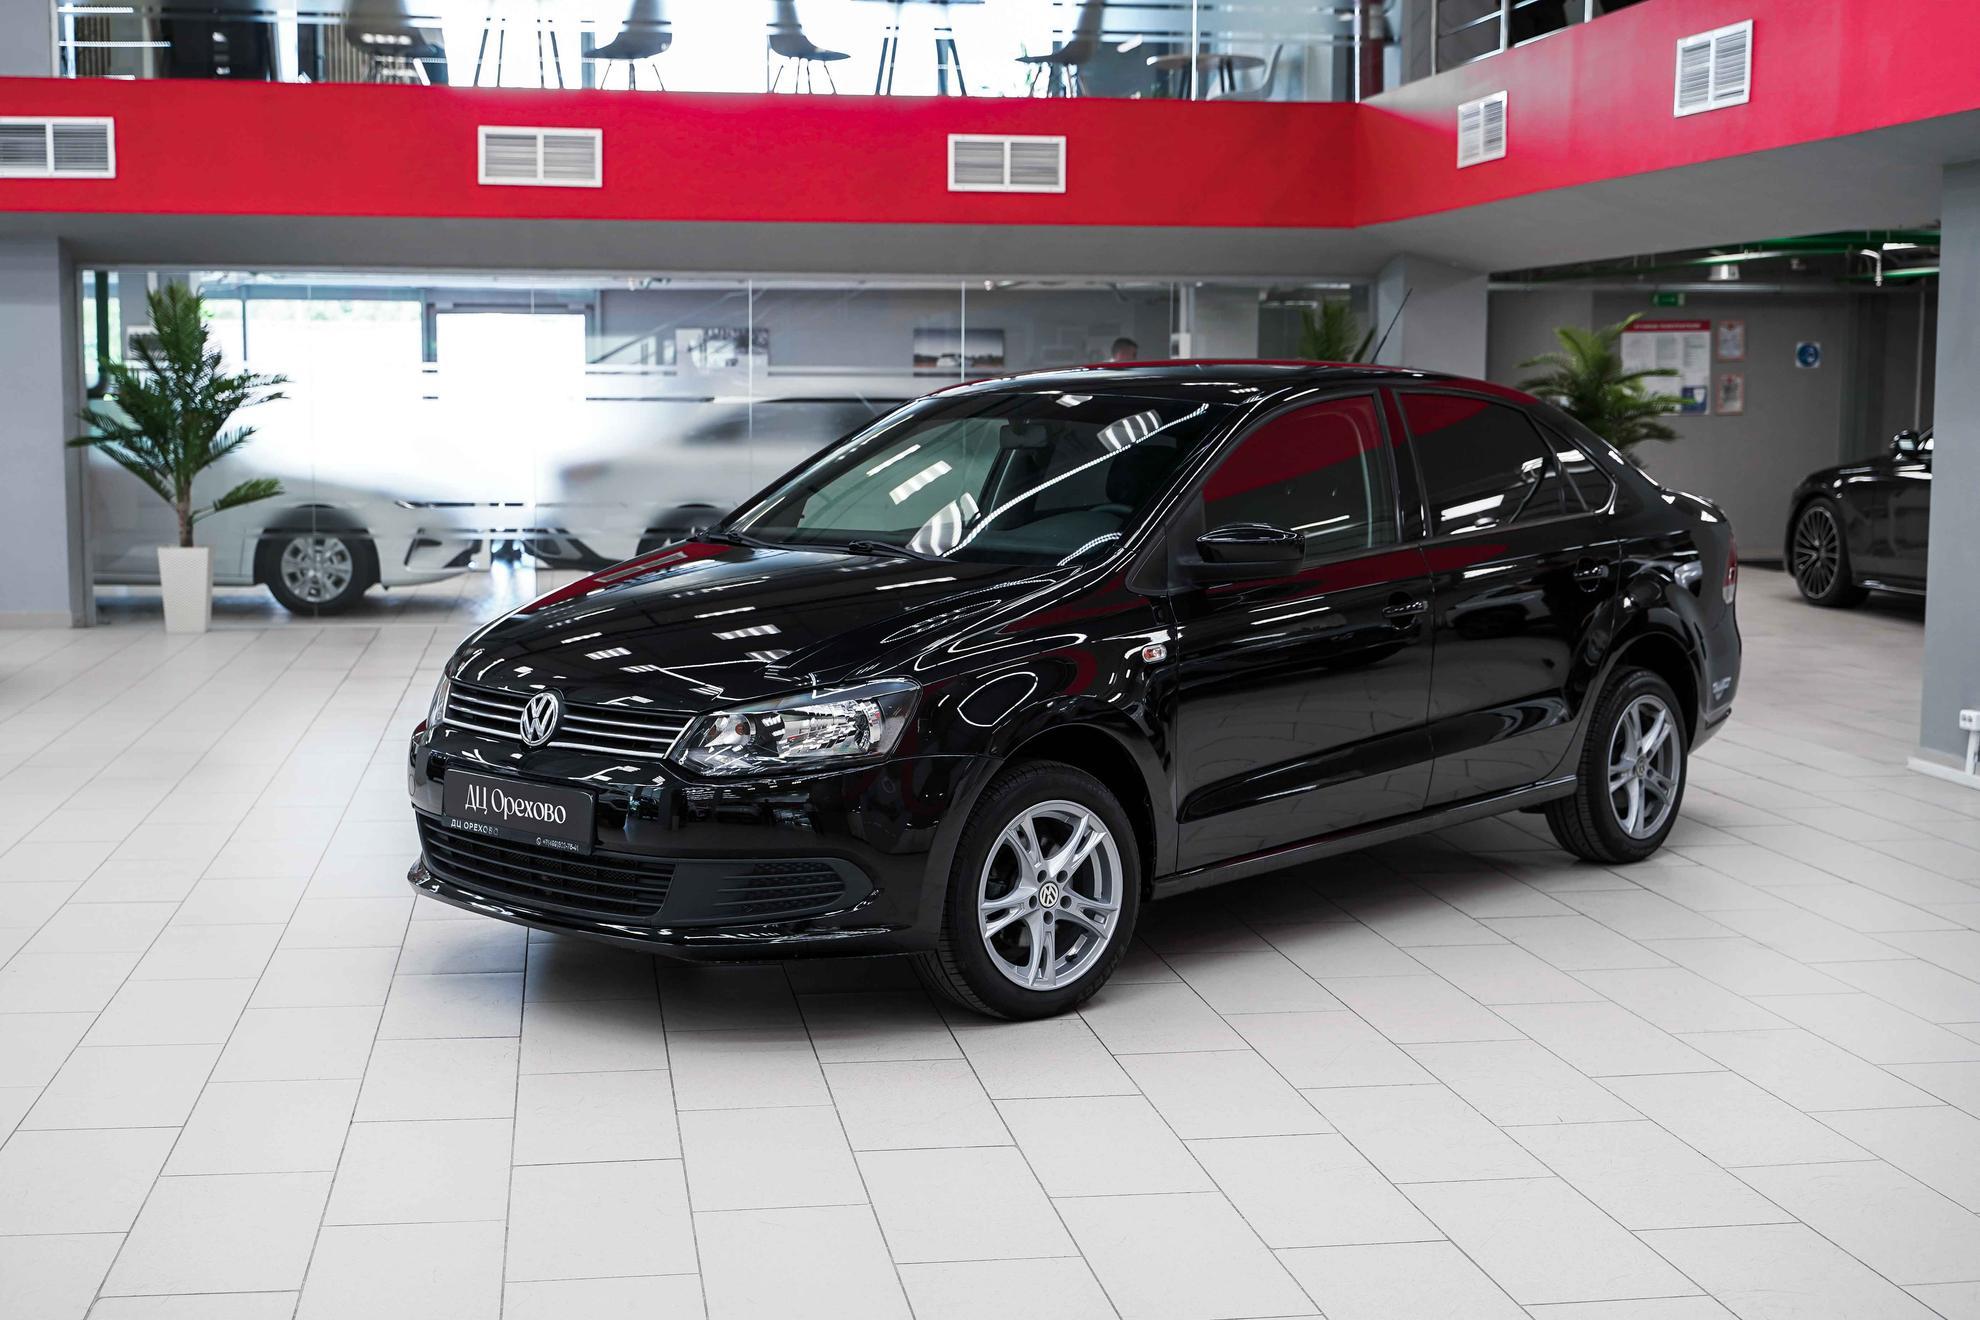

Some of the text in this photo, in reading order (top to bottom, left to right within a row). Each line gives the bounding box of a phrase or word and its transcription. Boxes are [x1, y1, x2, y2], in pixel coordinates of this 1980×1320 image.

[465, 784, 567, 824] ДЦ Орехово
[451, 819, 498, 835] ДЦ ОРЕХОВО
